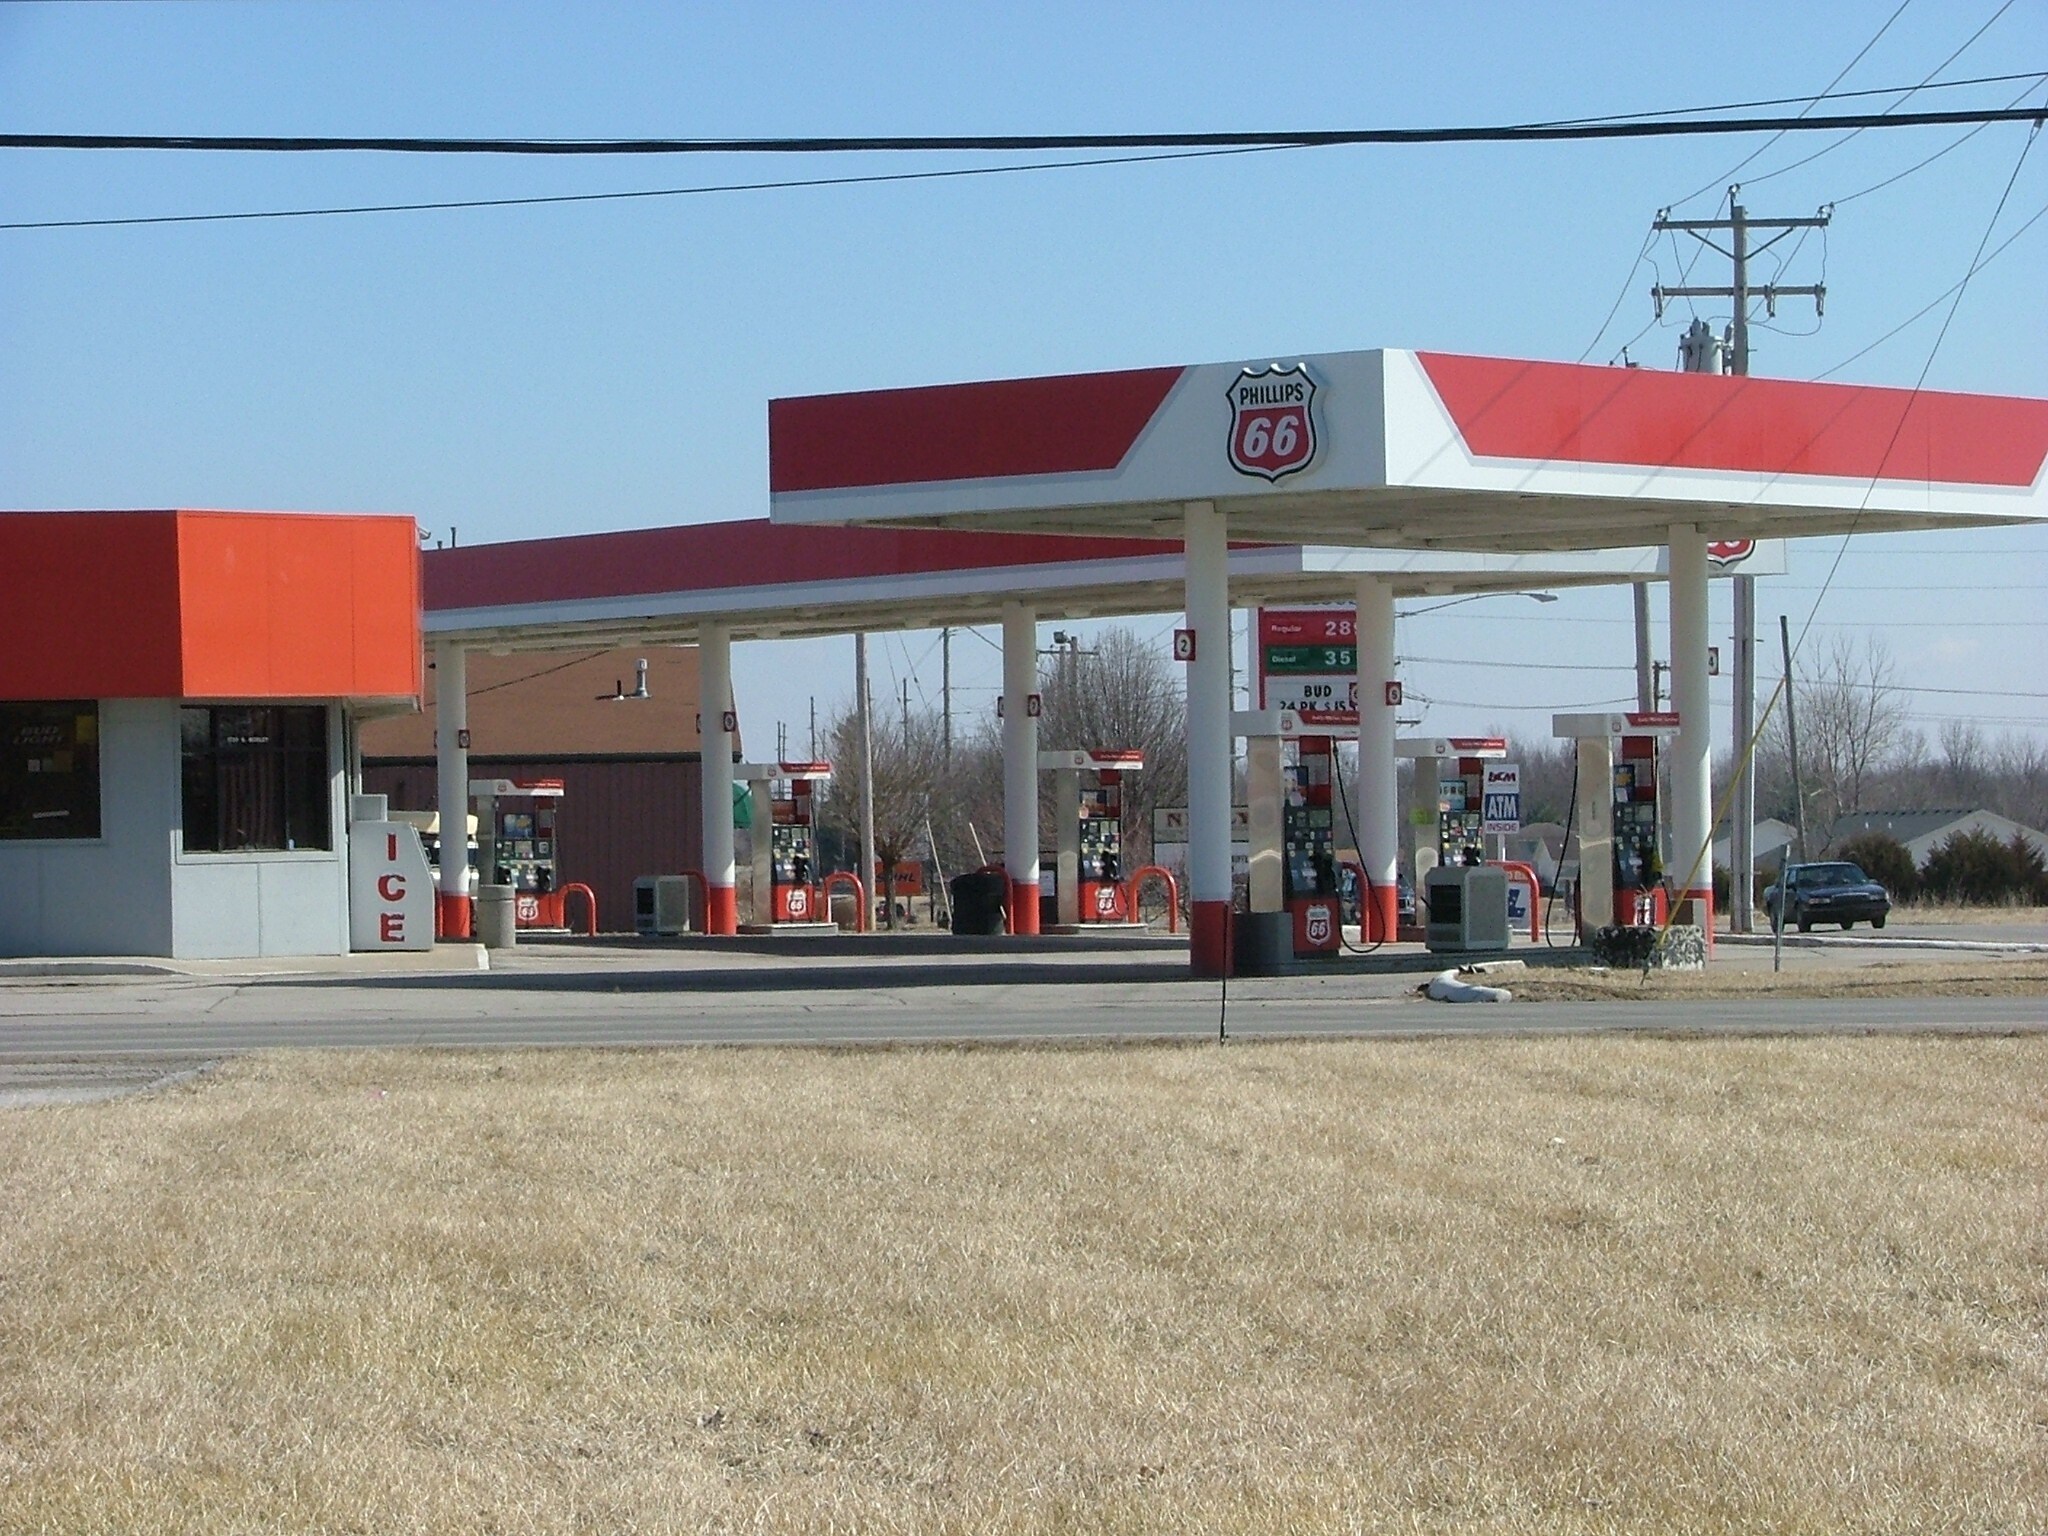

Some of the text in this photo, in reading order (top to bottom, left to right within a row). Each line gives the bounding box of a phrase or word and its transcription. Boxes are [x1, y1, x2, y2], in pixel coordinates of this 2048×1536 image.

[1240, 383, 1304, 405] PHILLIPS
[1243, 415, 1299, 458] 66
[1271, 621, 1357, 636] Regular 28
[1180, 639, 1188, 652] 2
[1271, 655, 1297, 663] Diesel
[1304, 685, 1332, 697] BUD
[1488, 796, 1517, 818] ATM
[1487, 823, 1517, 831] INSIDE
[378, 833, 406, 942] ICE
[1311, 921, 1326, 936] 66
